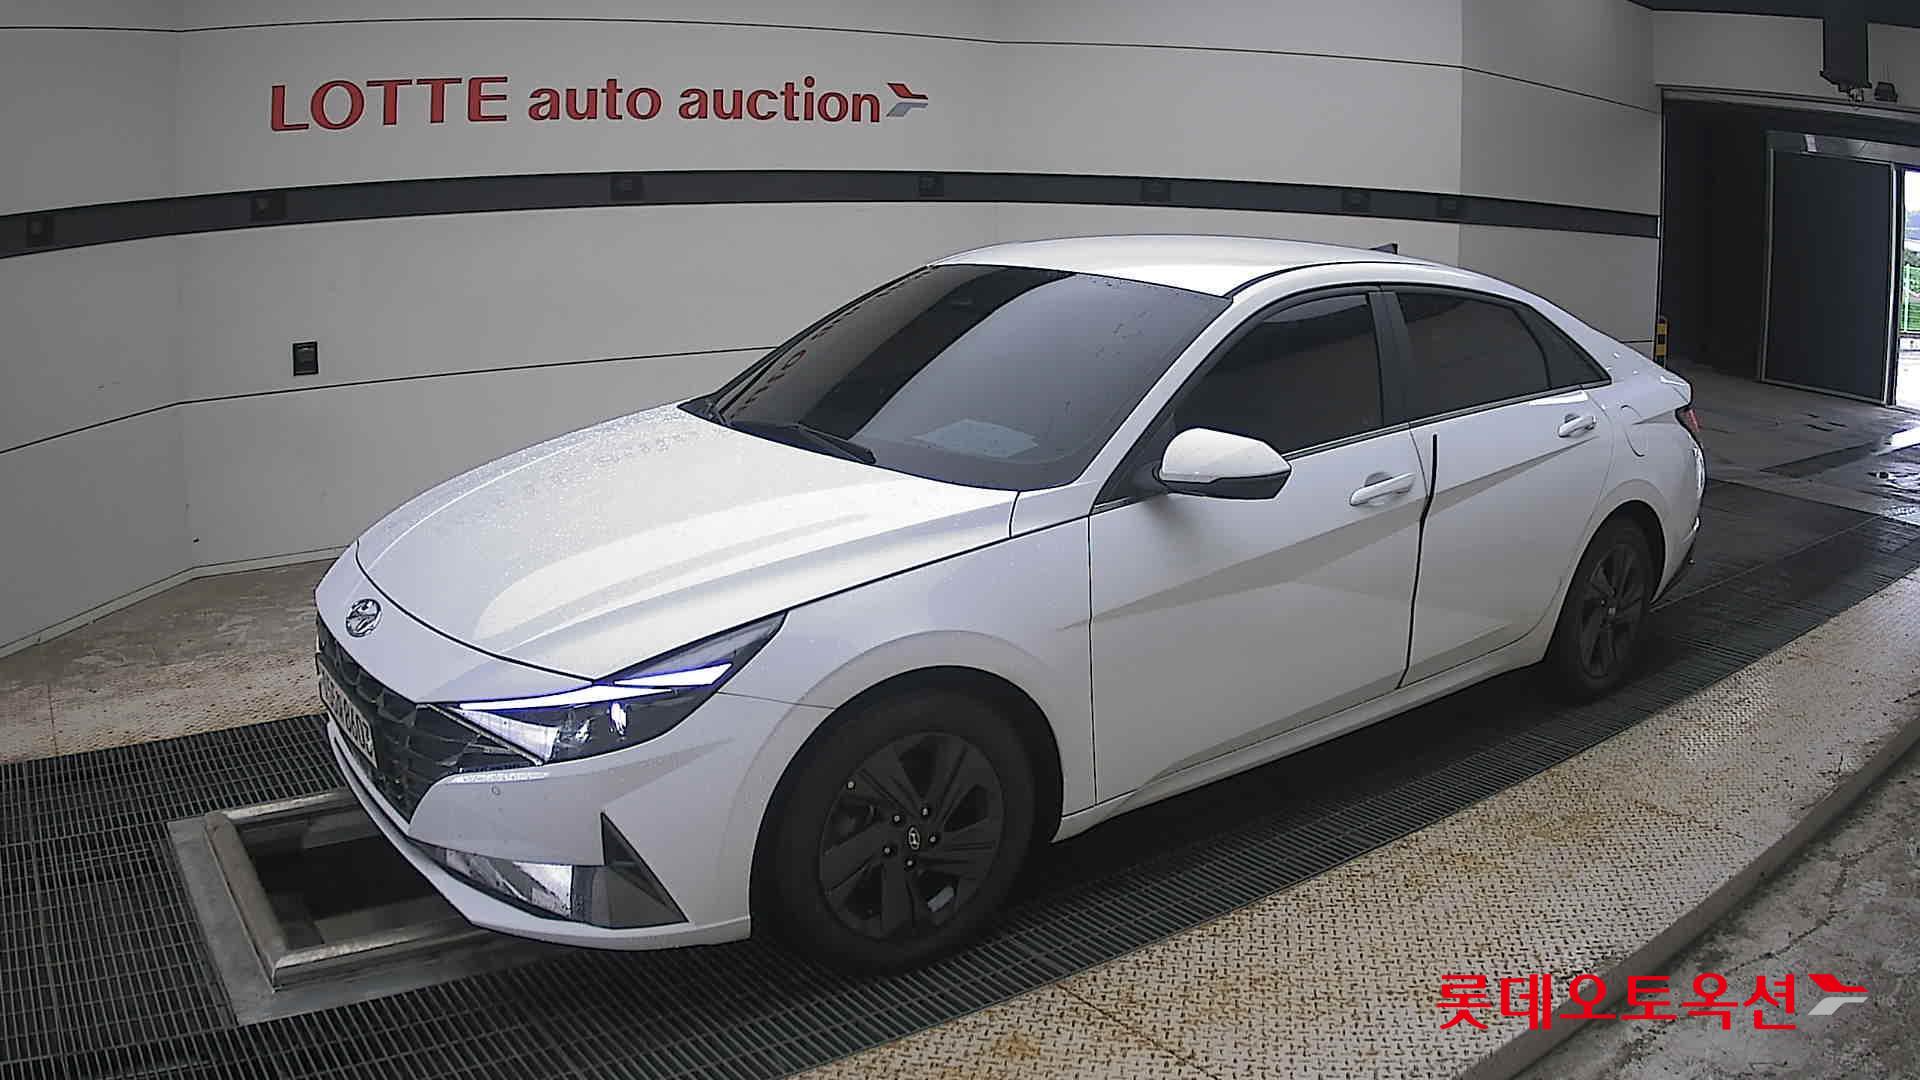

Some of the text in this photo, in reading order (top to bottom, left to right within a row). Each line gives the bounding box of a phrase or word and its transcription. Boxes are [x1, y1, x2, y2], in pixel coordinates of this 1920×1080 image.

[271, 76, 881, 131] LOTTE auto auction
